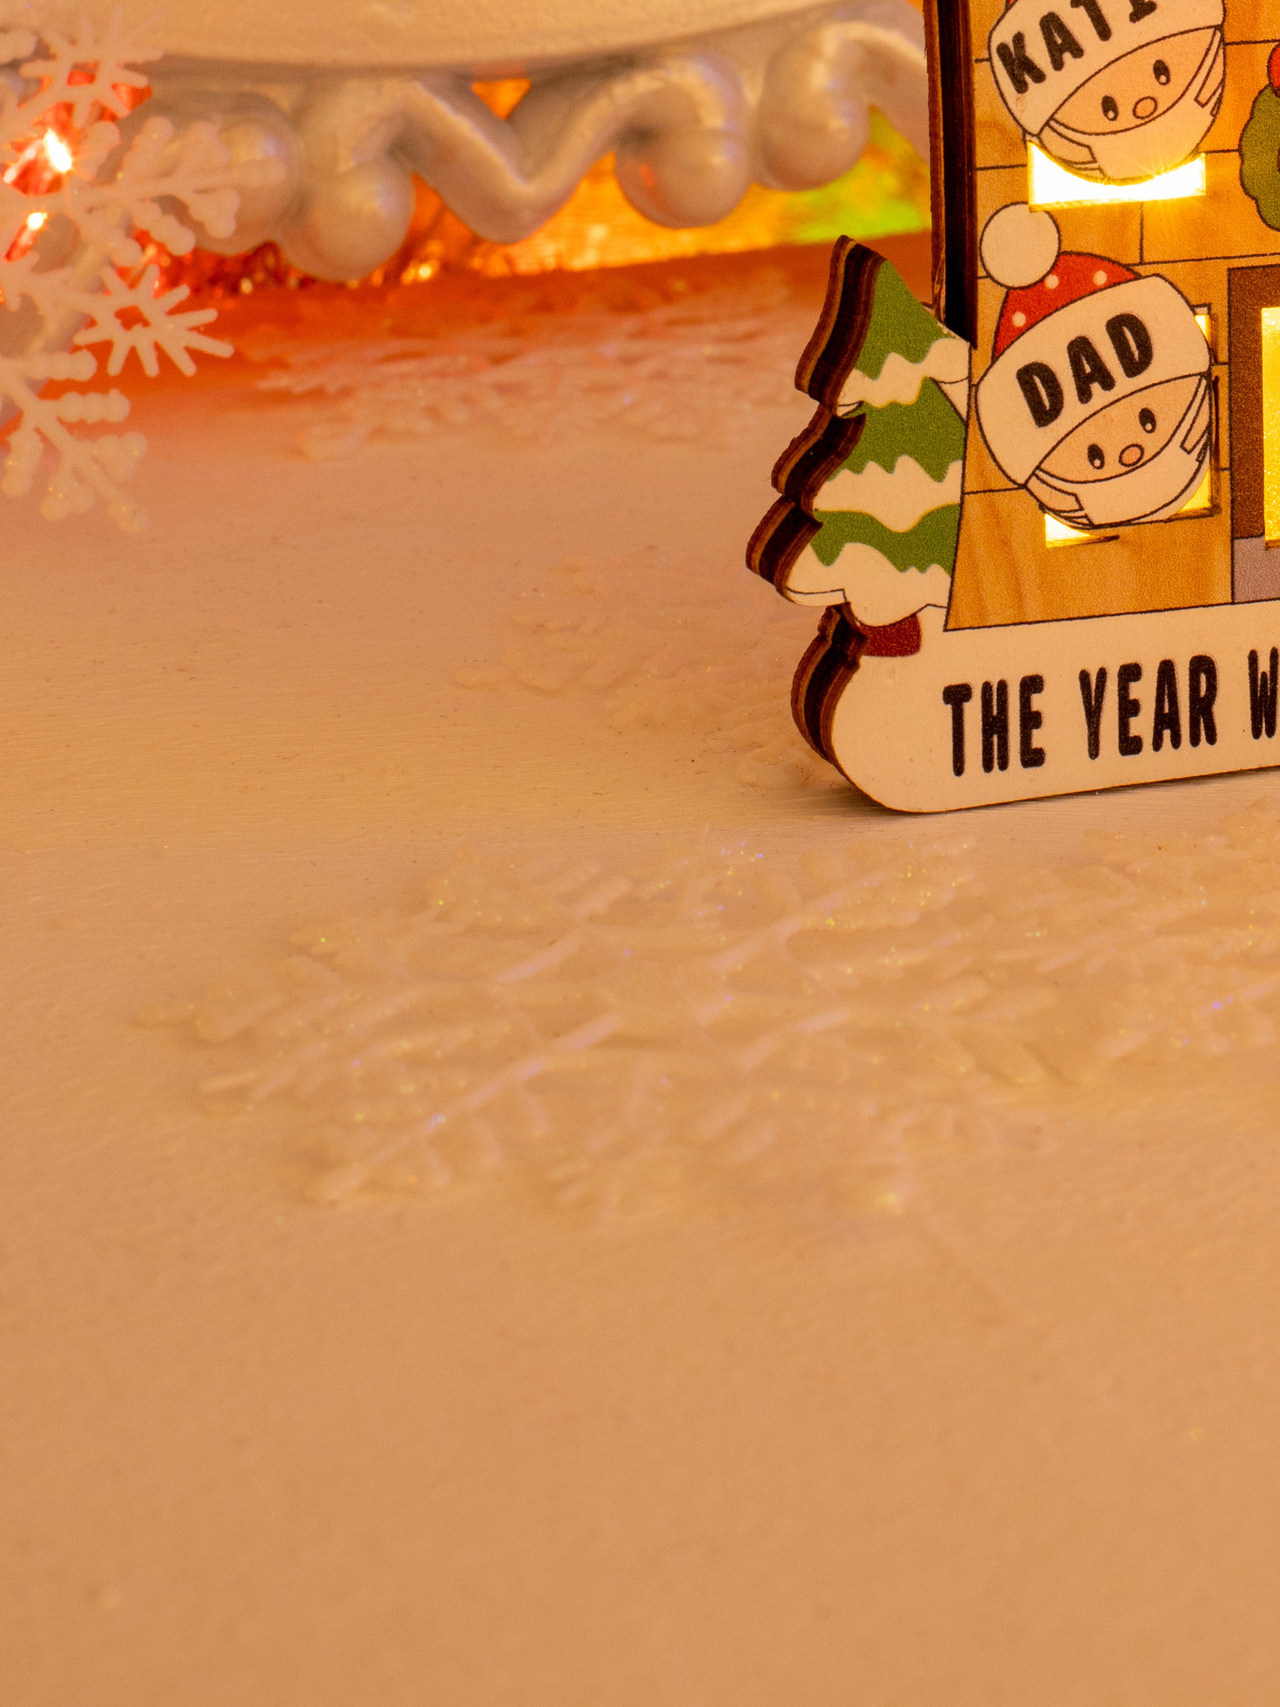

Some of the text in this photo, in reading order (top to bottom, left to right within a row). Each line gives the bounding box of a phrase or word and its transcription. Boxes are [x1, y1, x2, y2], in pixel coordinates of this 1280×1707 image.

[1016, 313, 1154, 429] DAD
[942, 674, 1046, 777] THE
[1078, 655, 1219, 761] YEAR
